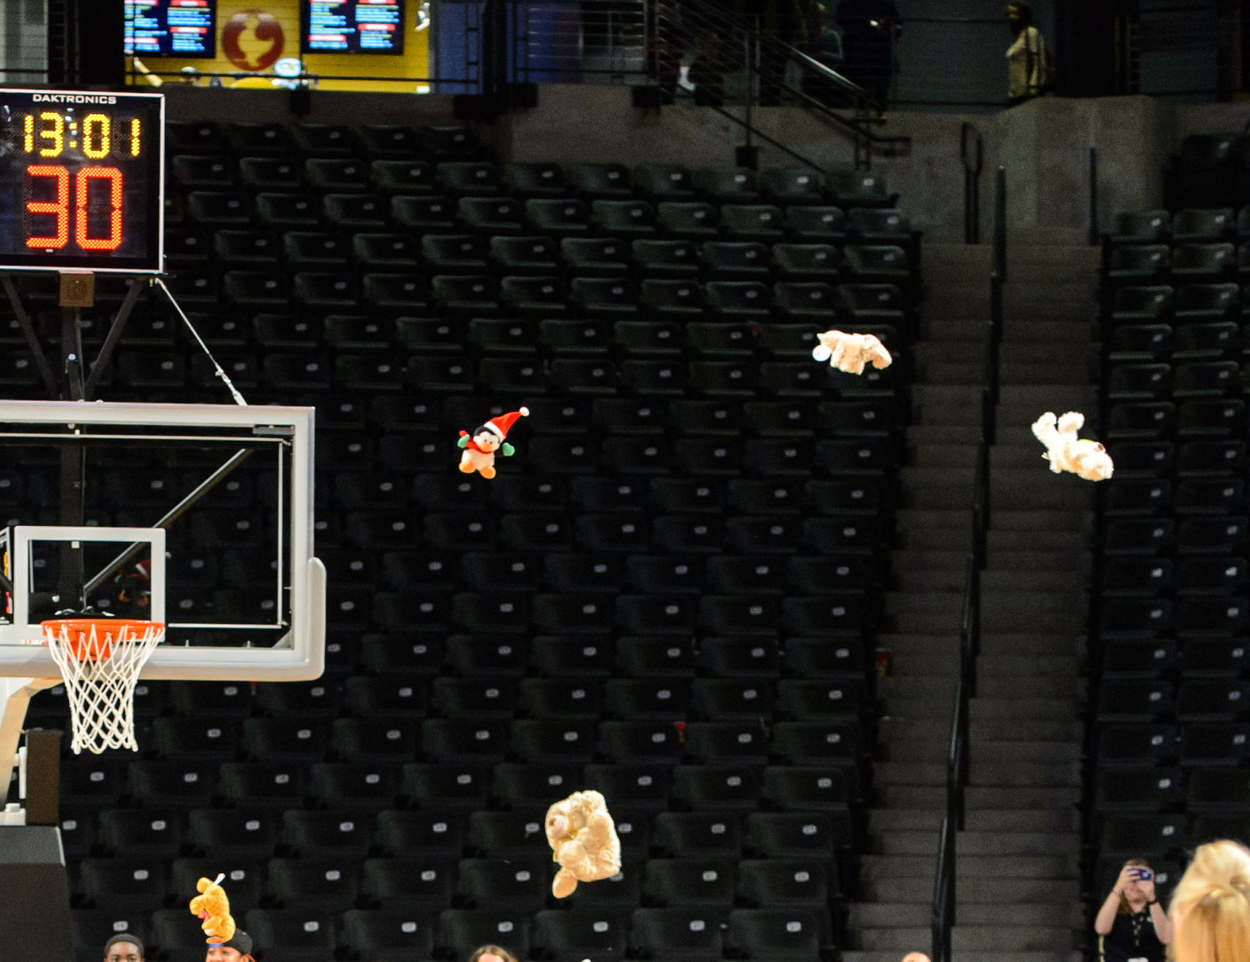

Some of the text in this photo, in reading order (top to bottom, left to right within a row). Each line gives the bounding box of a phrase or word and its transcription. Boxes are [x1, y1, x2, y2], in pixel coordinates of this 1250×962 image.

[32, 93, 117, 105] DAKTRONICS
[24, 112, 141, 159] 13:01
[26, 165, 123, 250] 30
